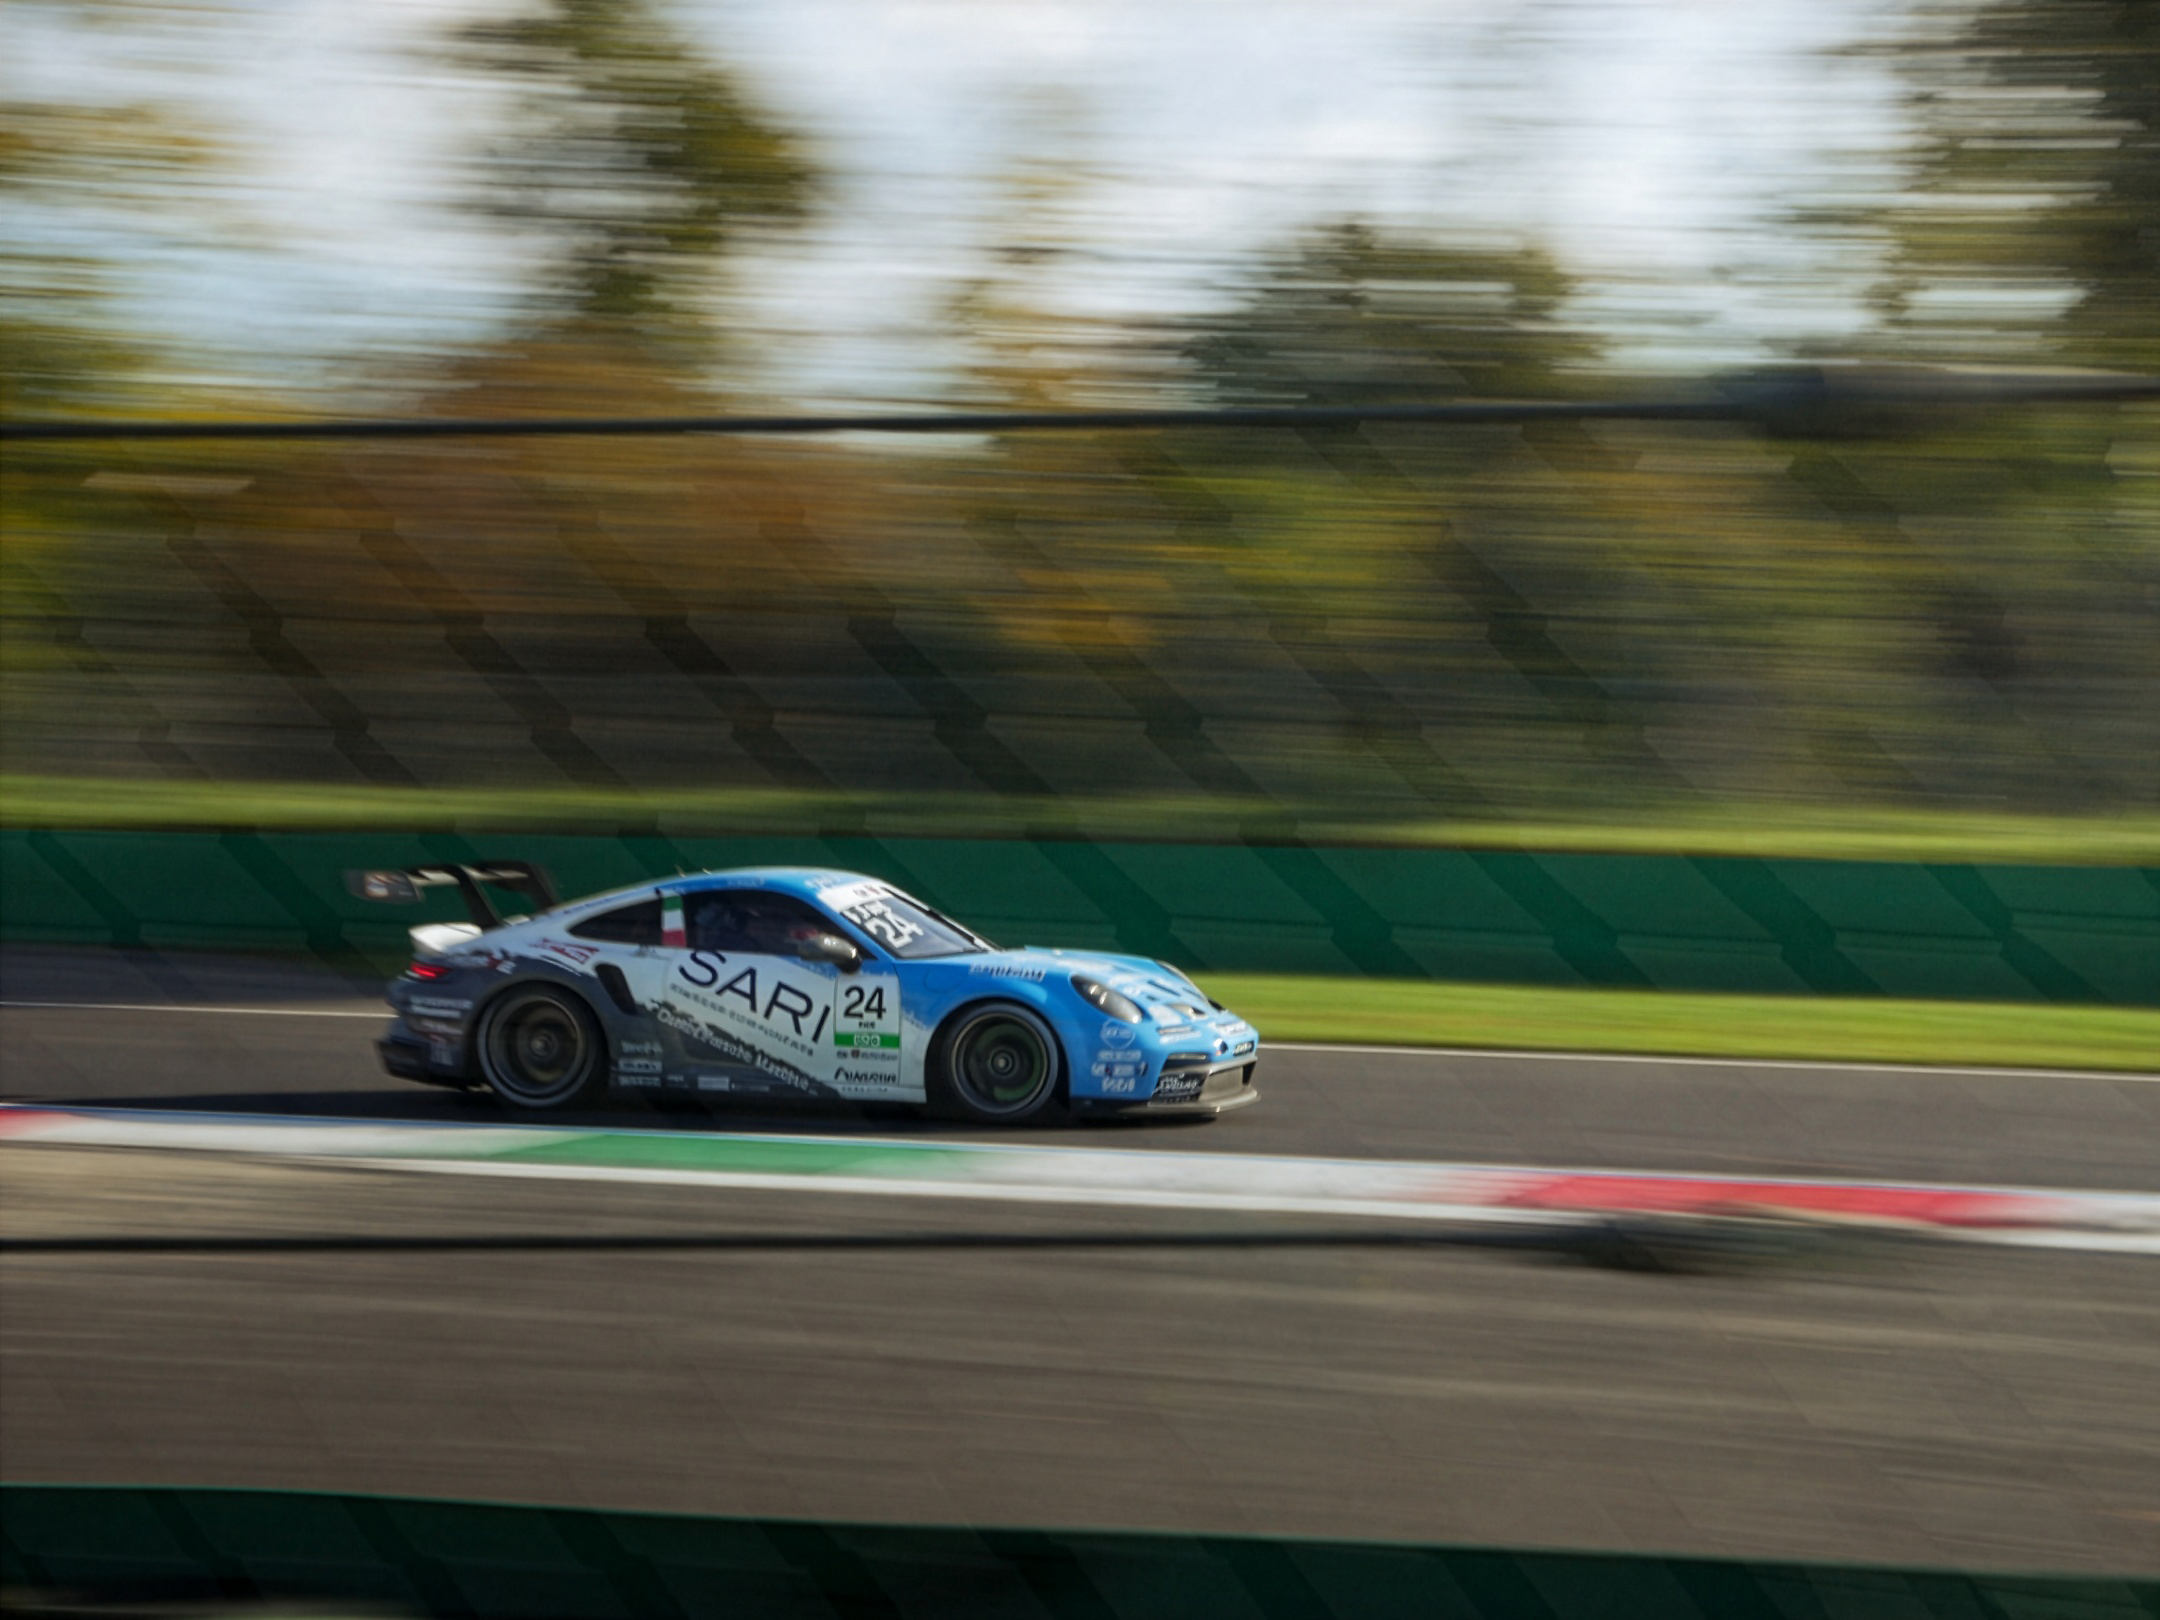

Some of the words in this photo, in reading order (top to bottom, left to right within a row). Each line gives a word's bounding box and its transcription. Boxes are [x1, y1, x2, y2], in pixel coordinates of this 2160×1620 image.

[865, 911, 923, 948] 24
[678, 949, 831, 1044] SARI
[843, 986, 887, 1021] 24
